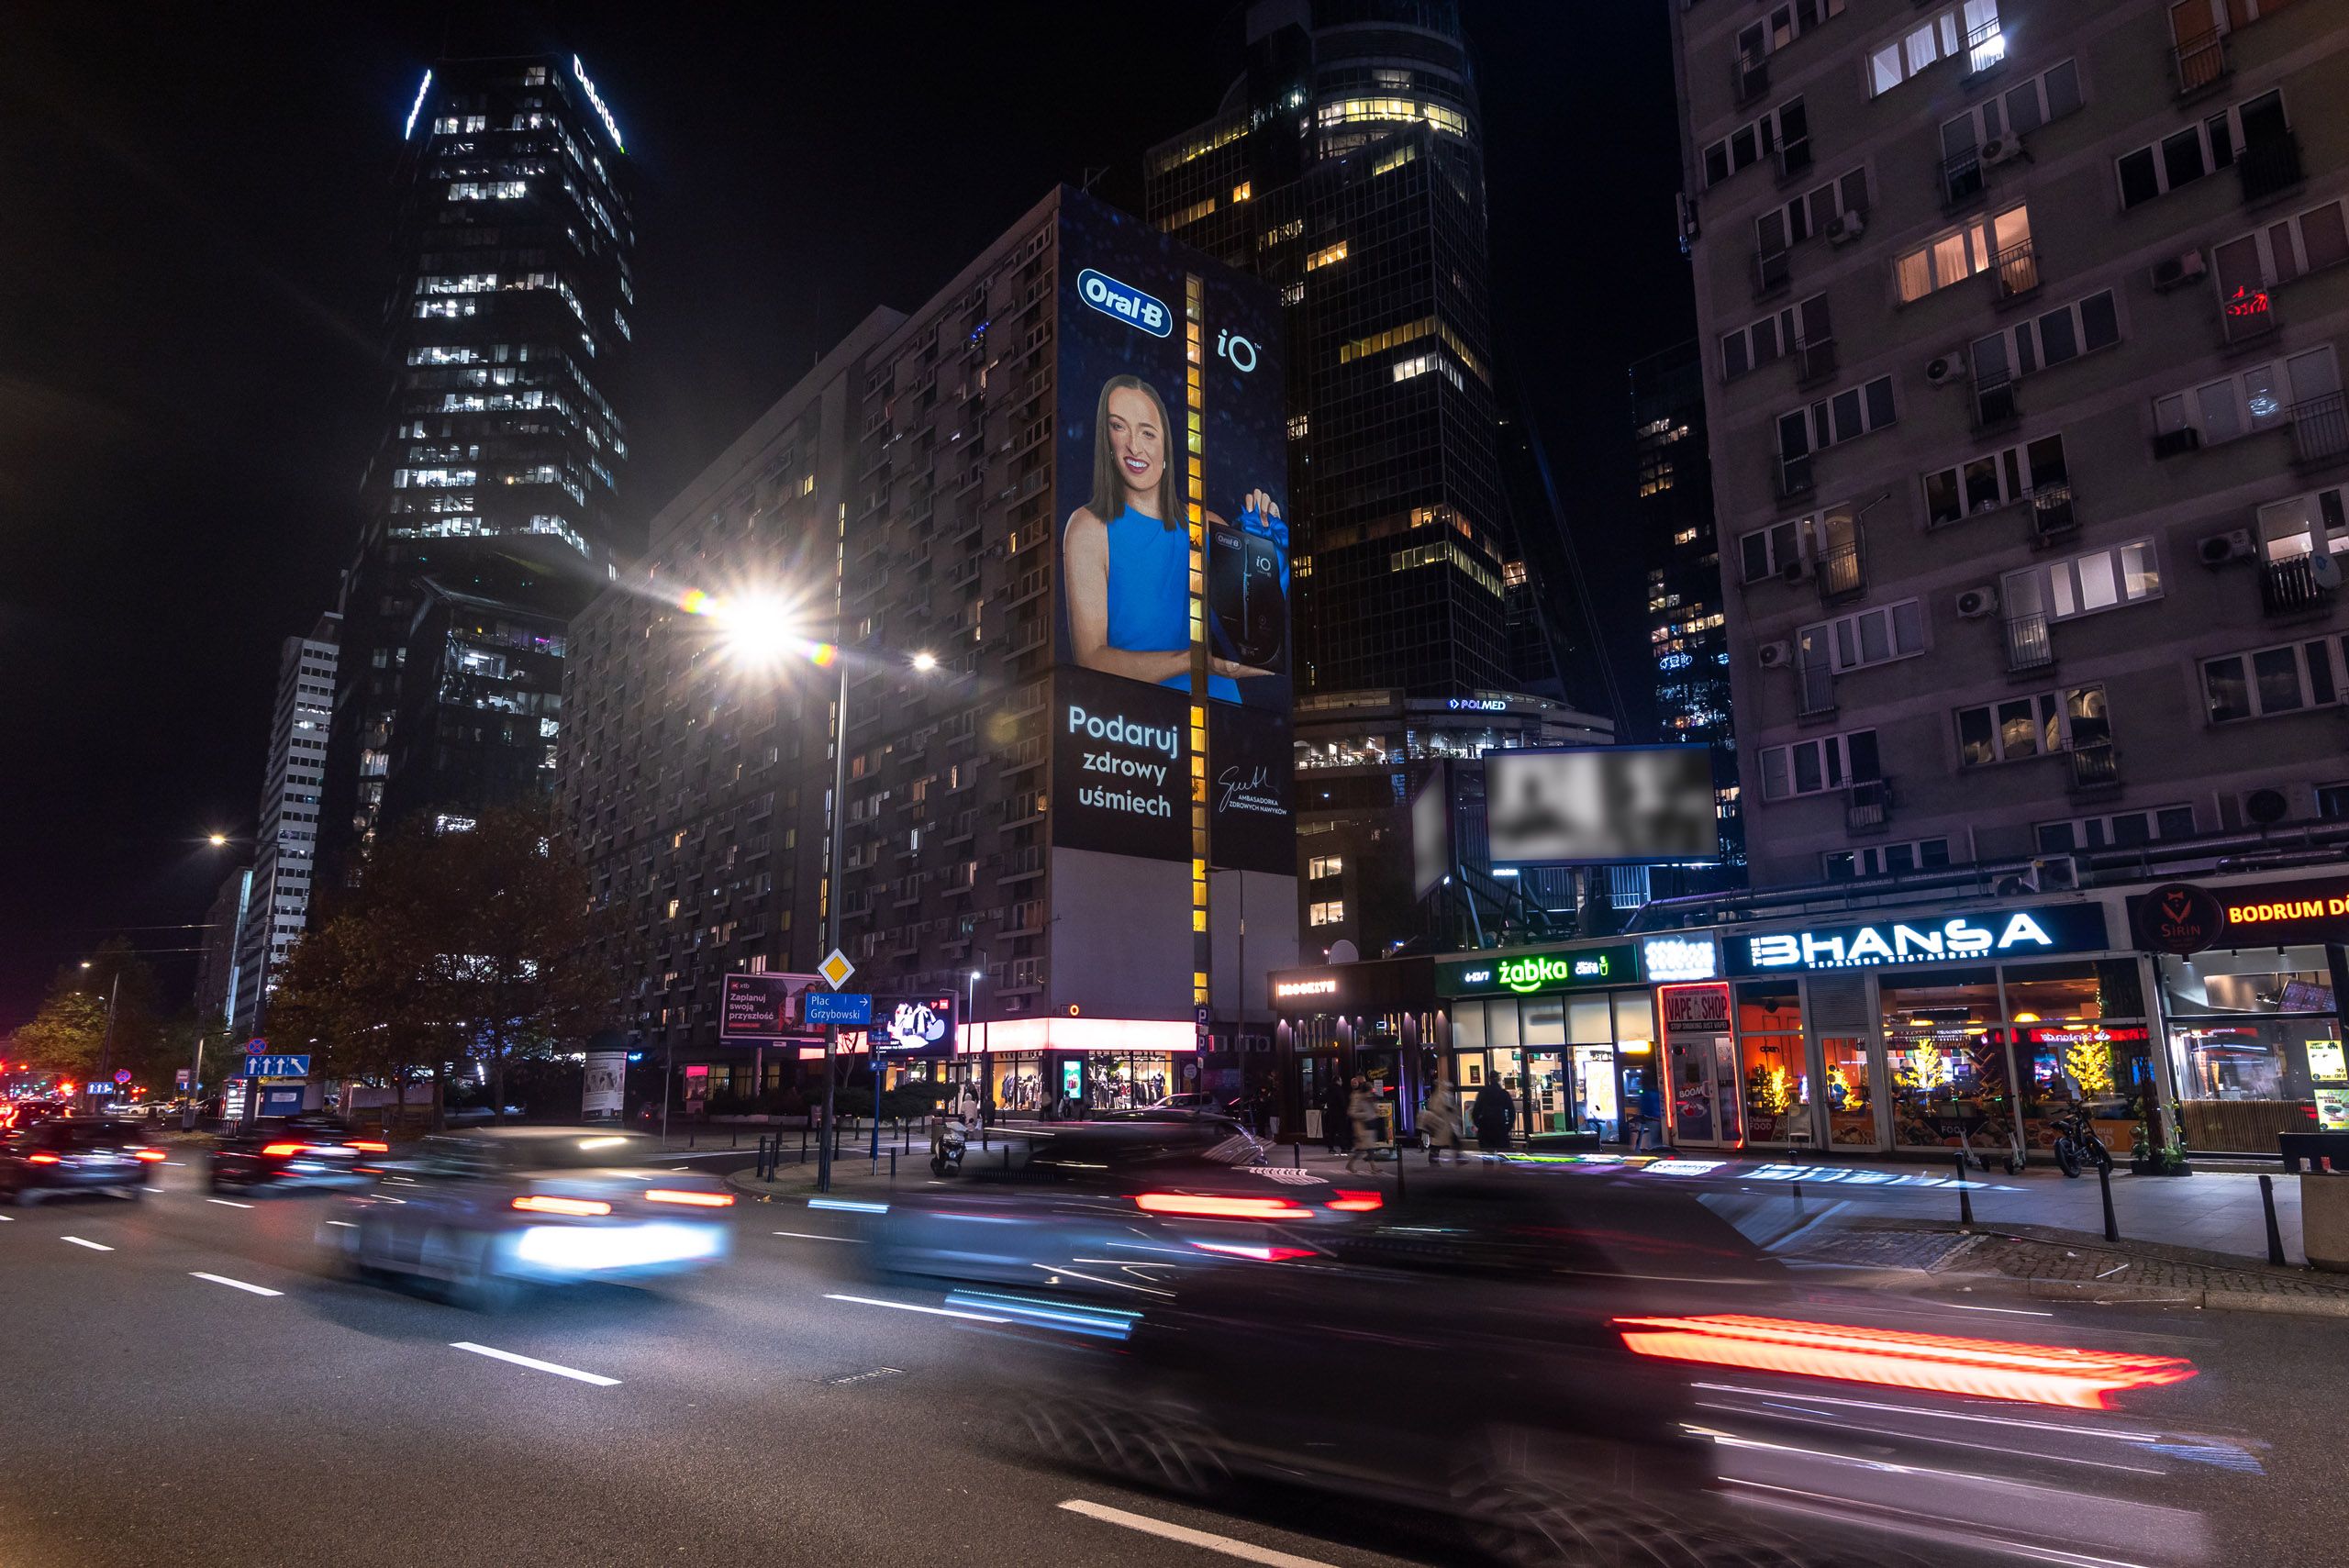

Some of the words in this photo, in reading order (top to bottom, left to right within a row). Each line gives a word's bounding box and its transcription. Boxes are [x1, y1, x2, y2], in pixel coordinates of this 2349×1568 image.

[1085, 277, 1163, 328] Oral-B
[1461, 699, 1506, 710] POLMED
[1069, 706, 1178, 760] Podaruj
[1083, 751, 1167, 787] zdrowy
[1079, 785, 1171, 817] uśmiech
[1238, 795, 1279, 806] AMBASADORKA
[1229, 800, 1260, 811] ZDROWYCH
[1260, 806, 1287, 816] NAWYKÓW
[2228, 900, 2324, 923] BODRUM
[2329, 894, 2349, 916] D
[1750, 937, 1761, 967] THE
[1760, 913, 2053, 967] BHANSA
[1887, 949, 1989, 963] RESTAURANT
[1497, 957, 1568, 984] żabka
[730, 993, 766, 1004] Zaplanuj
[811, 995, 829, 1006] Plac
[729, 1003, 754, 1012] swoją
[810, 1008, 861, 1021] Grzybowski
[1667, 997, 1693, 1021] VAPE
[1701, 995, 1727, 1020] SHOP
[729, 1011, 774, 1020] przyszłość
[1199, 1009, 1207, 1023] P
[1682, 1022, 1703, 1030] SMOKING
[1749, 1122, 1772, 1130] FOOD
